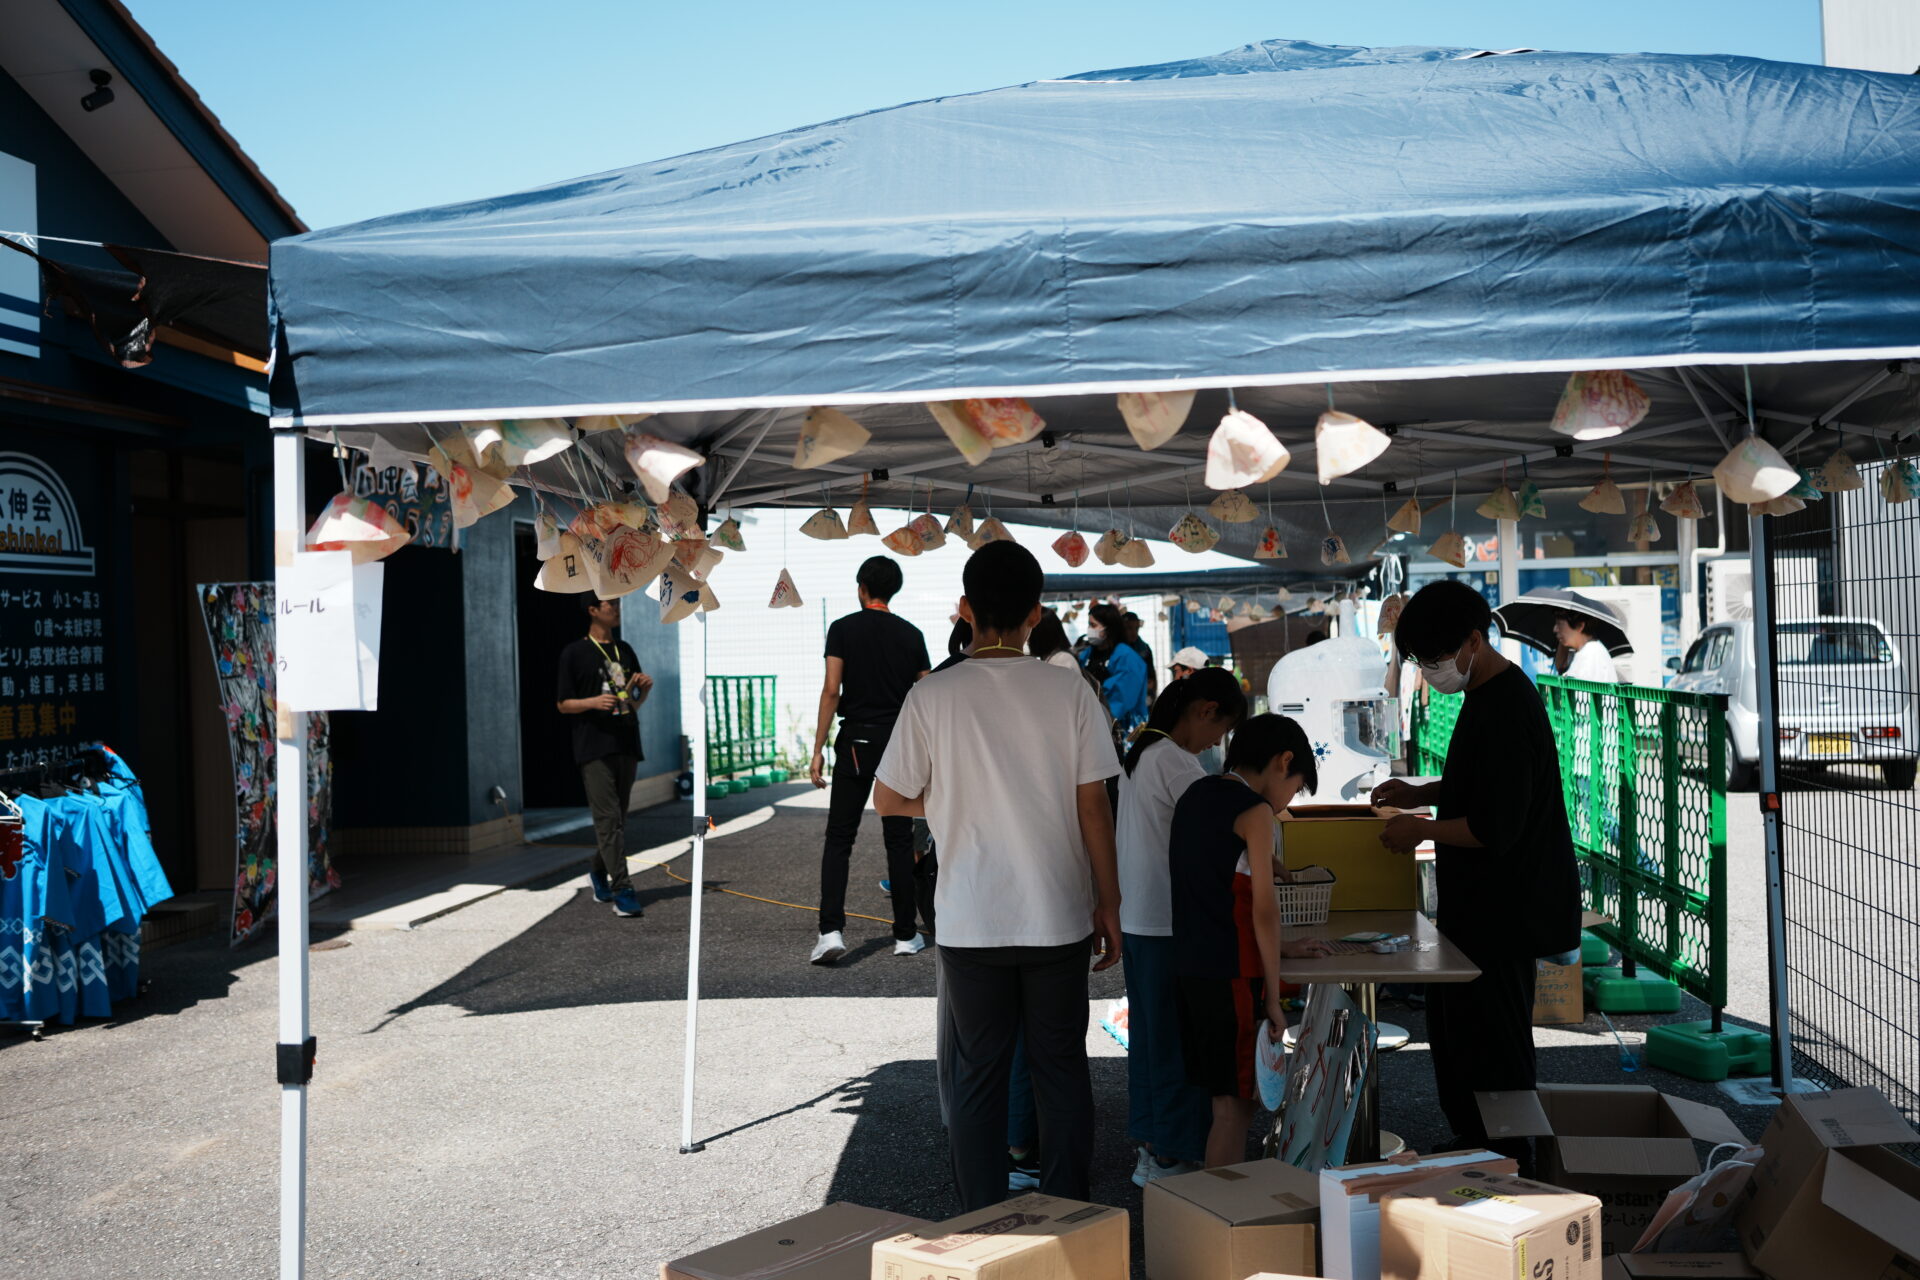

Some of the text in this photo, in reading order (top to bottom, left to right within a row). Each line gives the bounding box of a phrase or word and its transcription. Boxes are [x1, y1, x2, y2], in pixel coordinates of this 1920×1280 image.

[0, 487, 52, 523] 伸会
[280, 597, 325, 615] ルール
[1614, 1191, 1654, 1207] star
